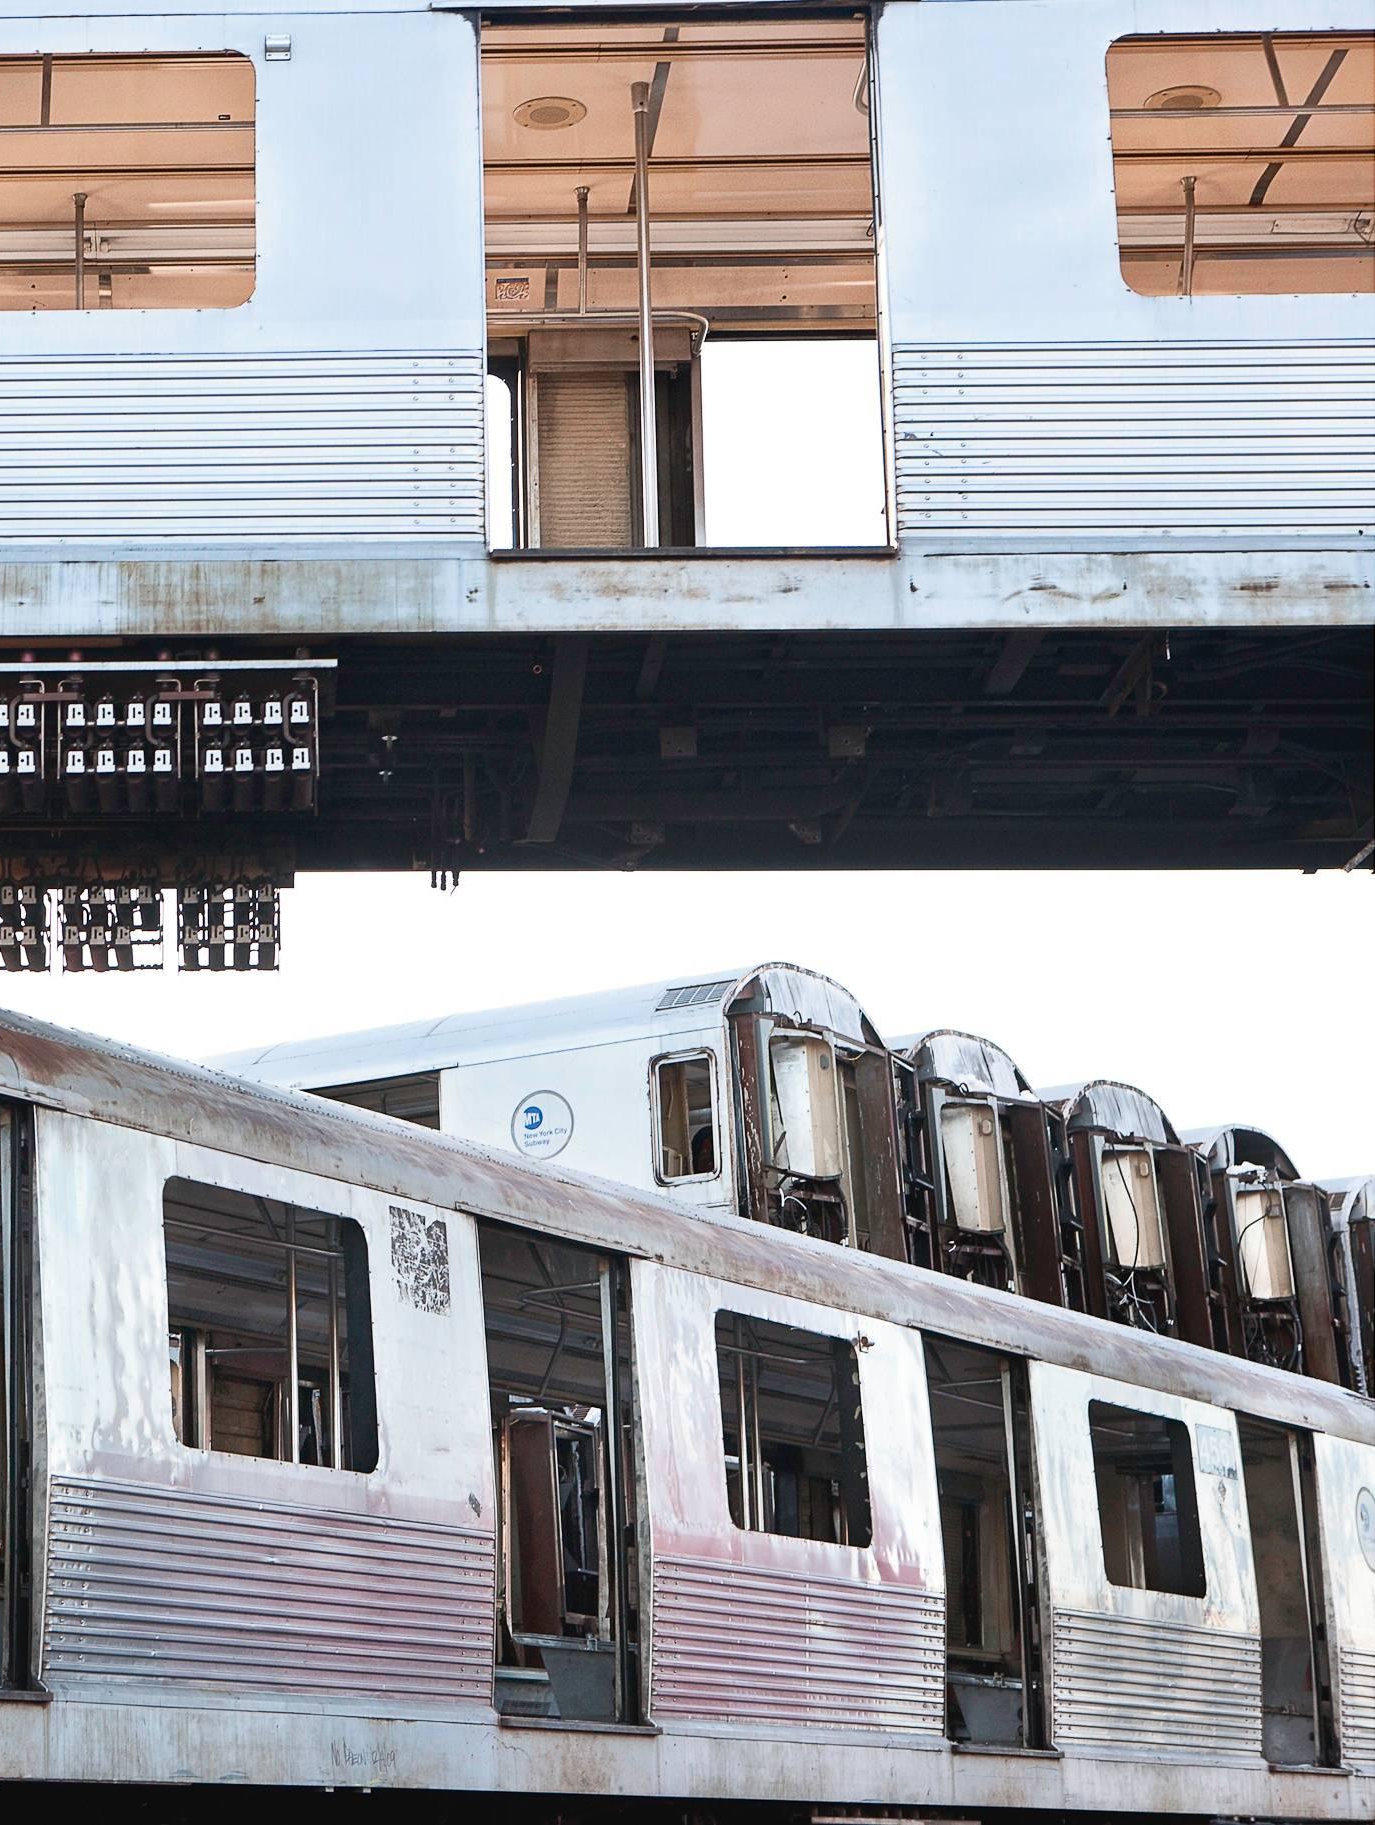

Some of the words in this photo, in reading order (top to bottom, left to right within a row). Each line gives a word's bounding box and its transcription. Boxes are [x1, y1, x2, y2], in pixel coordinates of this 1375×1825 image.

[523, 1111, 541, 1127] MTA
[539, 1129, 553, 1137] York
[524, 1139, 550, 1147] Subway
